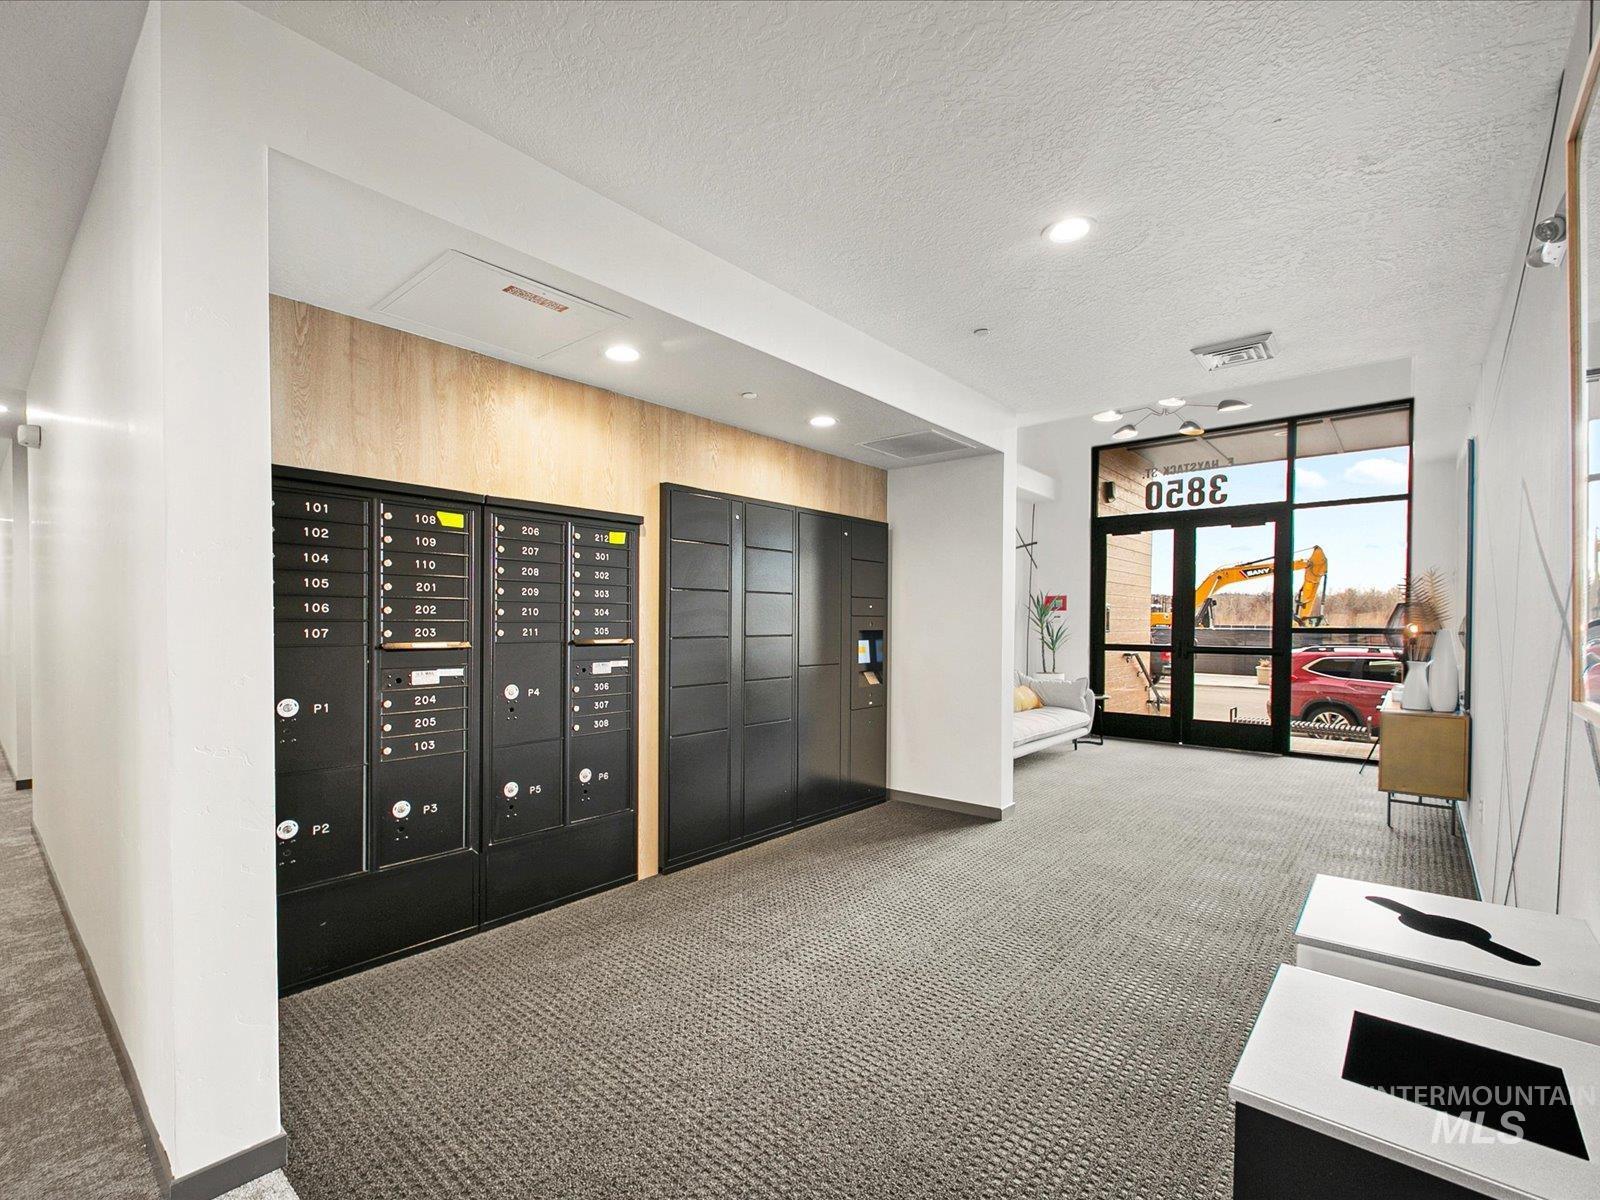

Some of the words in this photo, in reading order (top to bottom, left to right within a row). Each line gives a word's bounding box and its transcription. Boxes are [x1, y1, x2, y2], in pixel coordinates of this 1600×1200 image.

[305, 502, 328, 513] 101
[415, 514, 437, 524] 108
[303, 527, 329, 538] 102
[521, 526, 540, 536] 206
[415, 537, 437, 547] 109
[594, 534, 609, 542] 212
[521, 547, 540, 555] 207
[303, 553, 330, 563] 104
[594, 553, 610, 561] 301
[415, 560, 436, 569] 110
[521, 567, 540, 576] 208
[593, 571, 610, 580] 302
[1247, 568, 1270, 576] SANY
[303, 578, 330, 588] 105
[415, 583, 436, 591] 201
[521, 588, 540, 596] 209
[594, 590, 610, 598] 303
[303, 603, 330, 613] 106
[414, 605, 437, 614] 202
[521, 608, 540, 616] 210
[593, 608, 610, 617] 304
[303, 629, 329, 638] 107
[414, 628, 437, 637] 203
[522, 628, 539, 636] 211
[593, 627, 610, 636] 305
[593, 682, 610, 691] 306
[527, 688, 541, 697] P4
[414, 695, 437, 705] 204
[593, 700, 610, 709] 307
[313, 703, 329, 713] P1
[414, 717, 437, 728] 205
[592, 719, 610, 728] 308
[414, 740, 436, 751] 103
[598, 772, 609, 780] P6
[529, 785, 542, 794] P5
[423, 804, 438, 814] P3
[312, 824, 330, 835] P2
